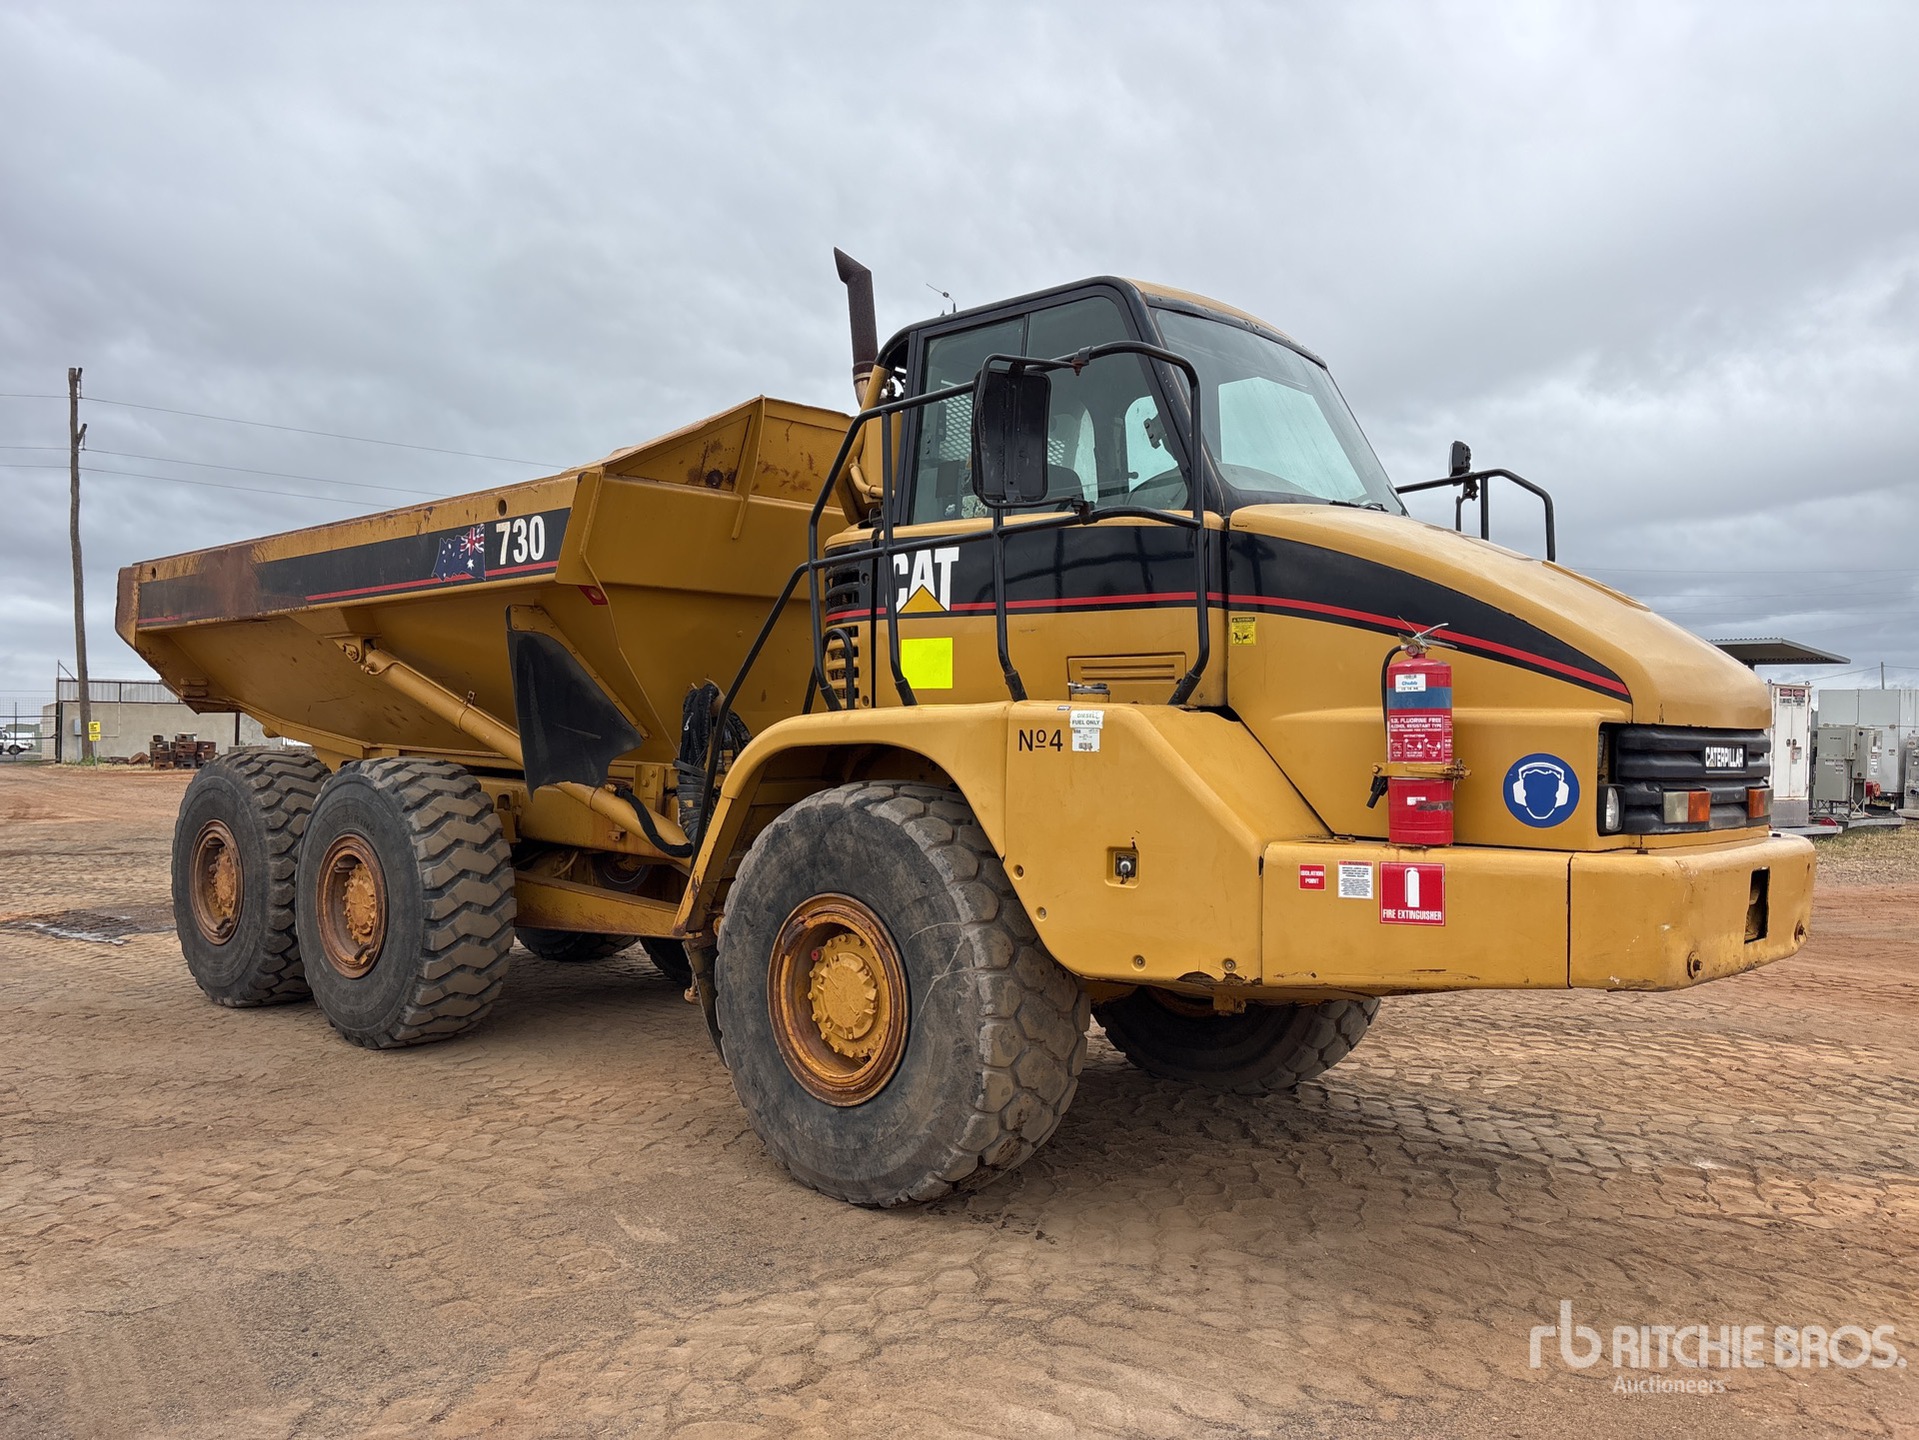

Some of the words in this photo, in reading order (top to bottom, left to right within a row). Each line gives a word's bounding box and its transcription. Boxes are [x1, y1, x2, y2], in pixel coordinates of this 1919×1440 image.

[496, 515, 546, 566] 730
[885, 546, 960, 614] CAT
[1705, 746, 1744, 768] CATERPILLAR
[1382, 909, 1396, 919] FIRE
[1397, 910, 1442, 921] EXTINGUISHER
